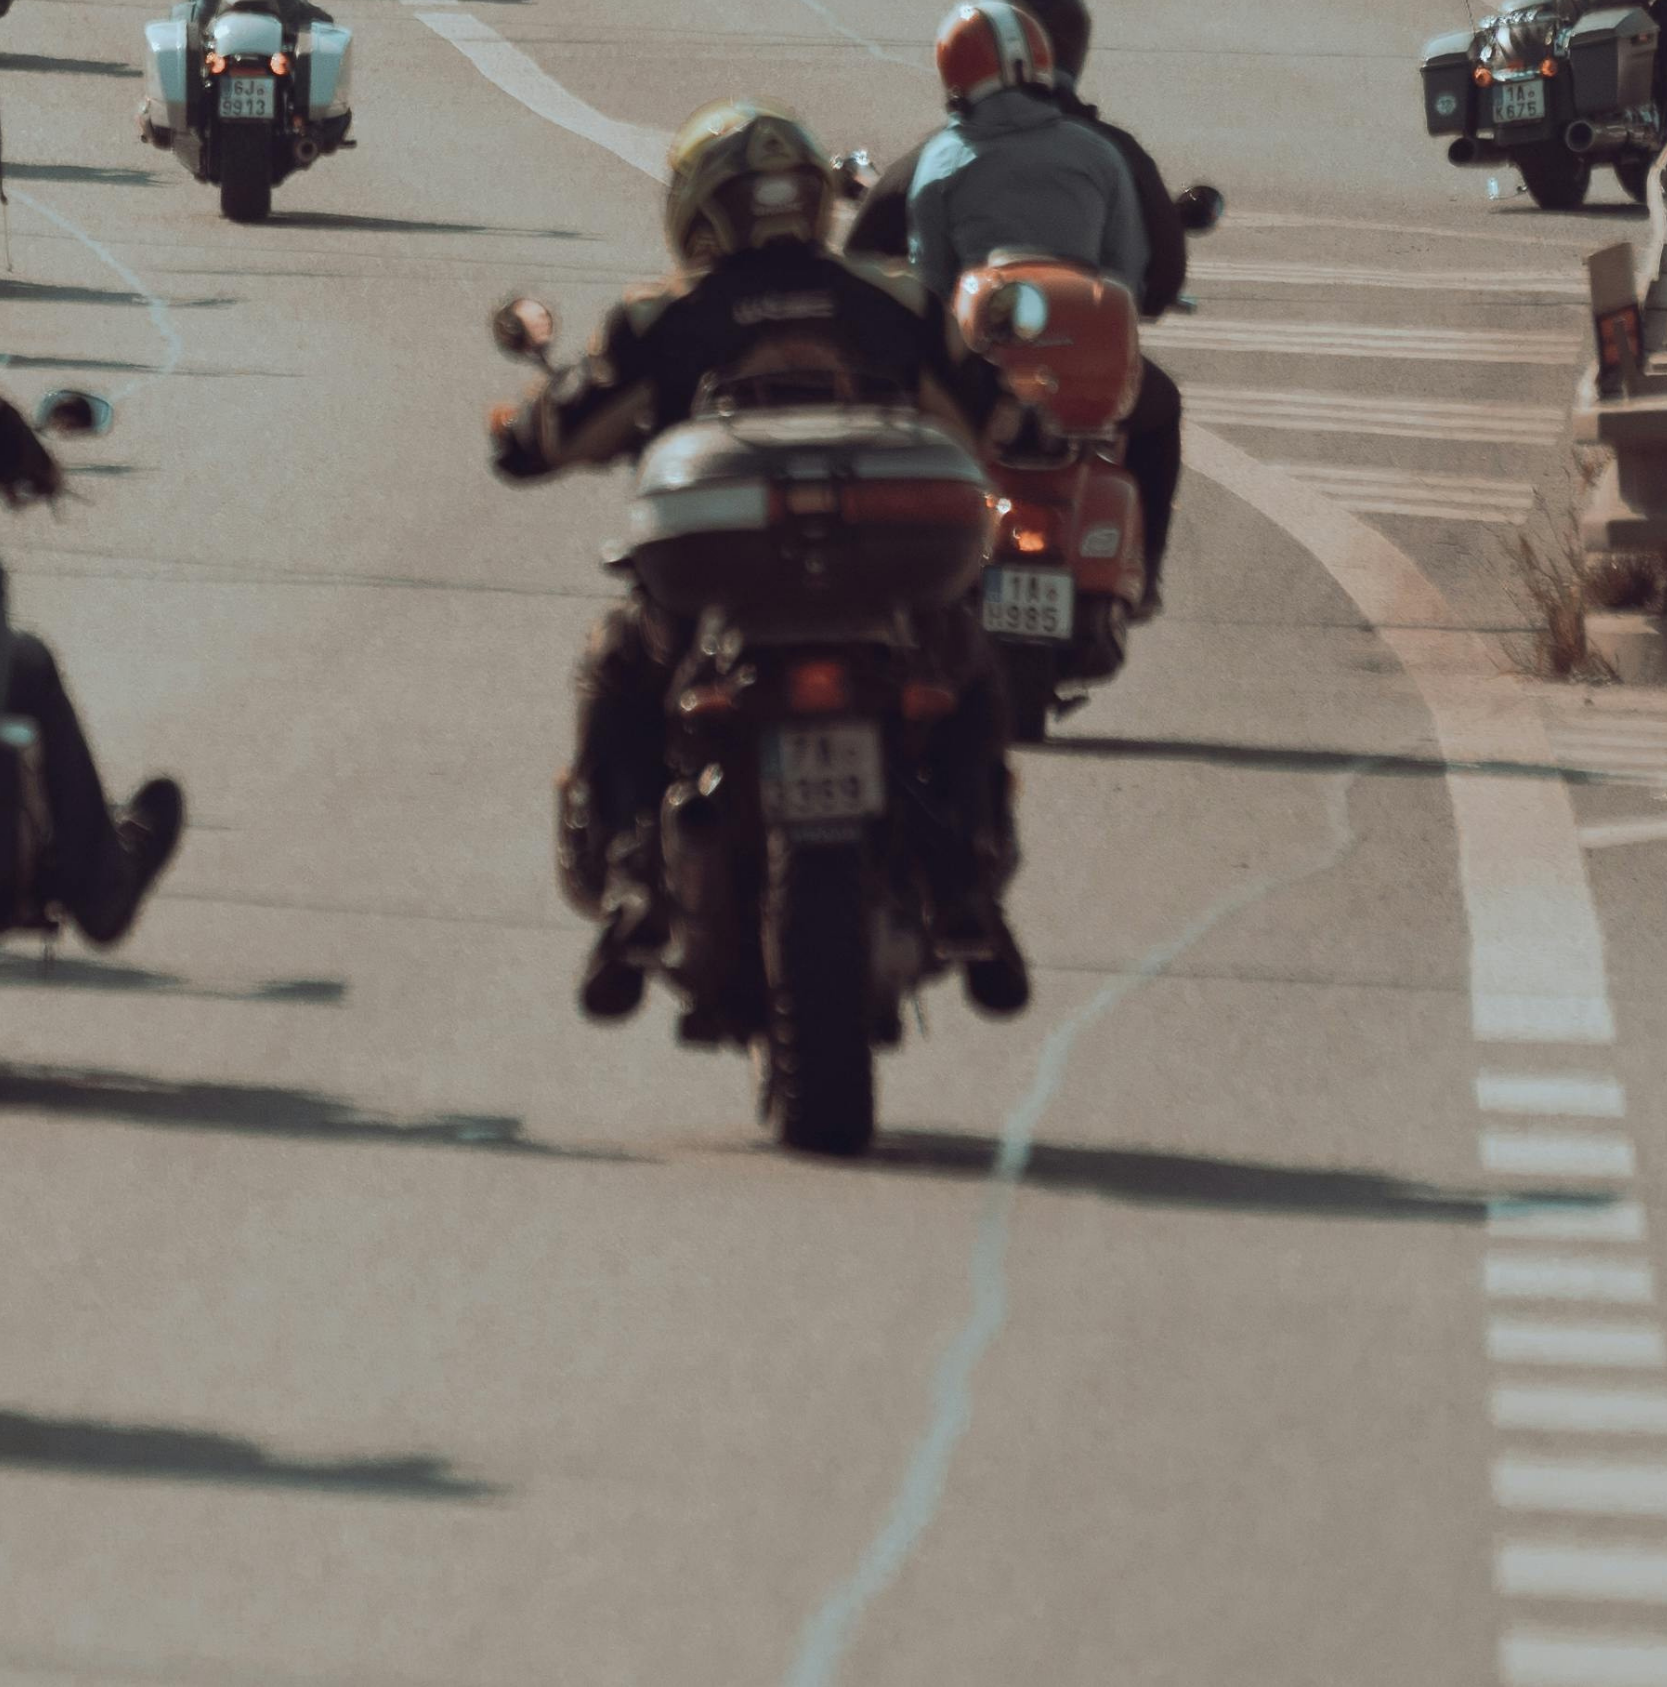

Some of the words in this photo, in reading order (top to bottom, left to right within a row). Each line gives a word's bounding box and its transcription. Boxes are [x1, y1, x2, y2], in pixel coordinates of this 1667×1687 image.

[234, 81, 254, 96] 6J
[1506, 85, 1525, 103] 1A
[222, 99, 266, 116] 9913
[1496, 102, 1537, 121] K675
